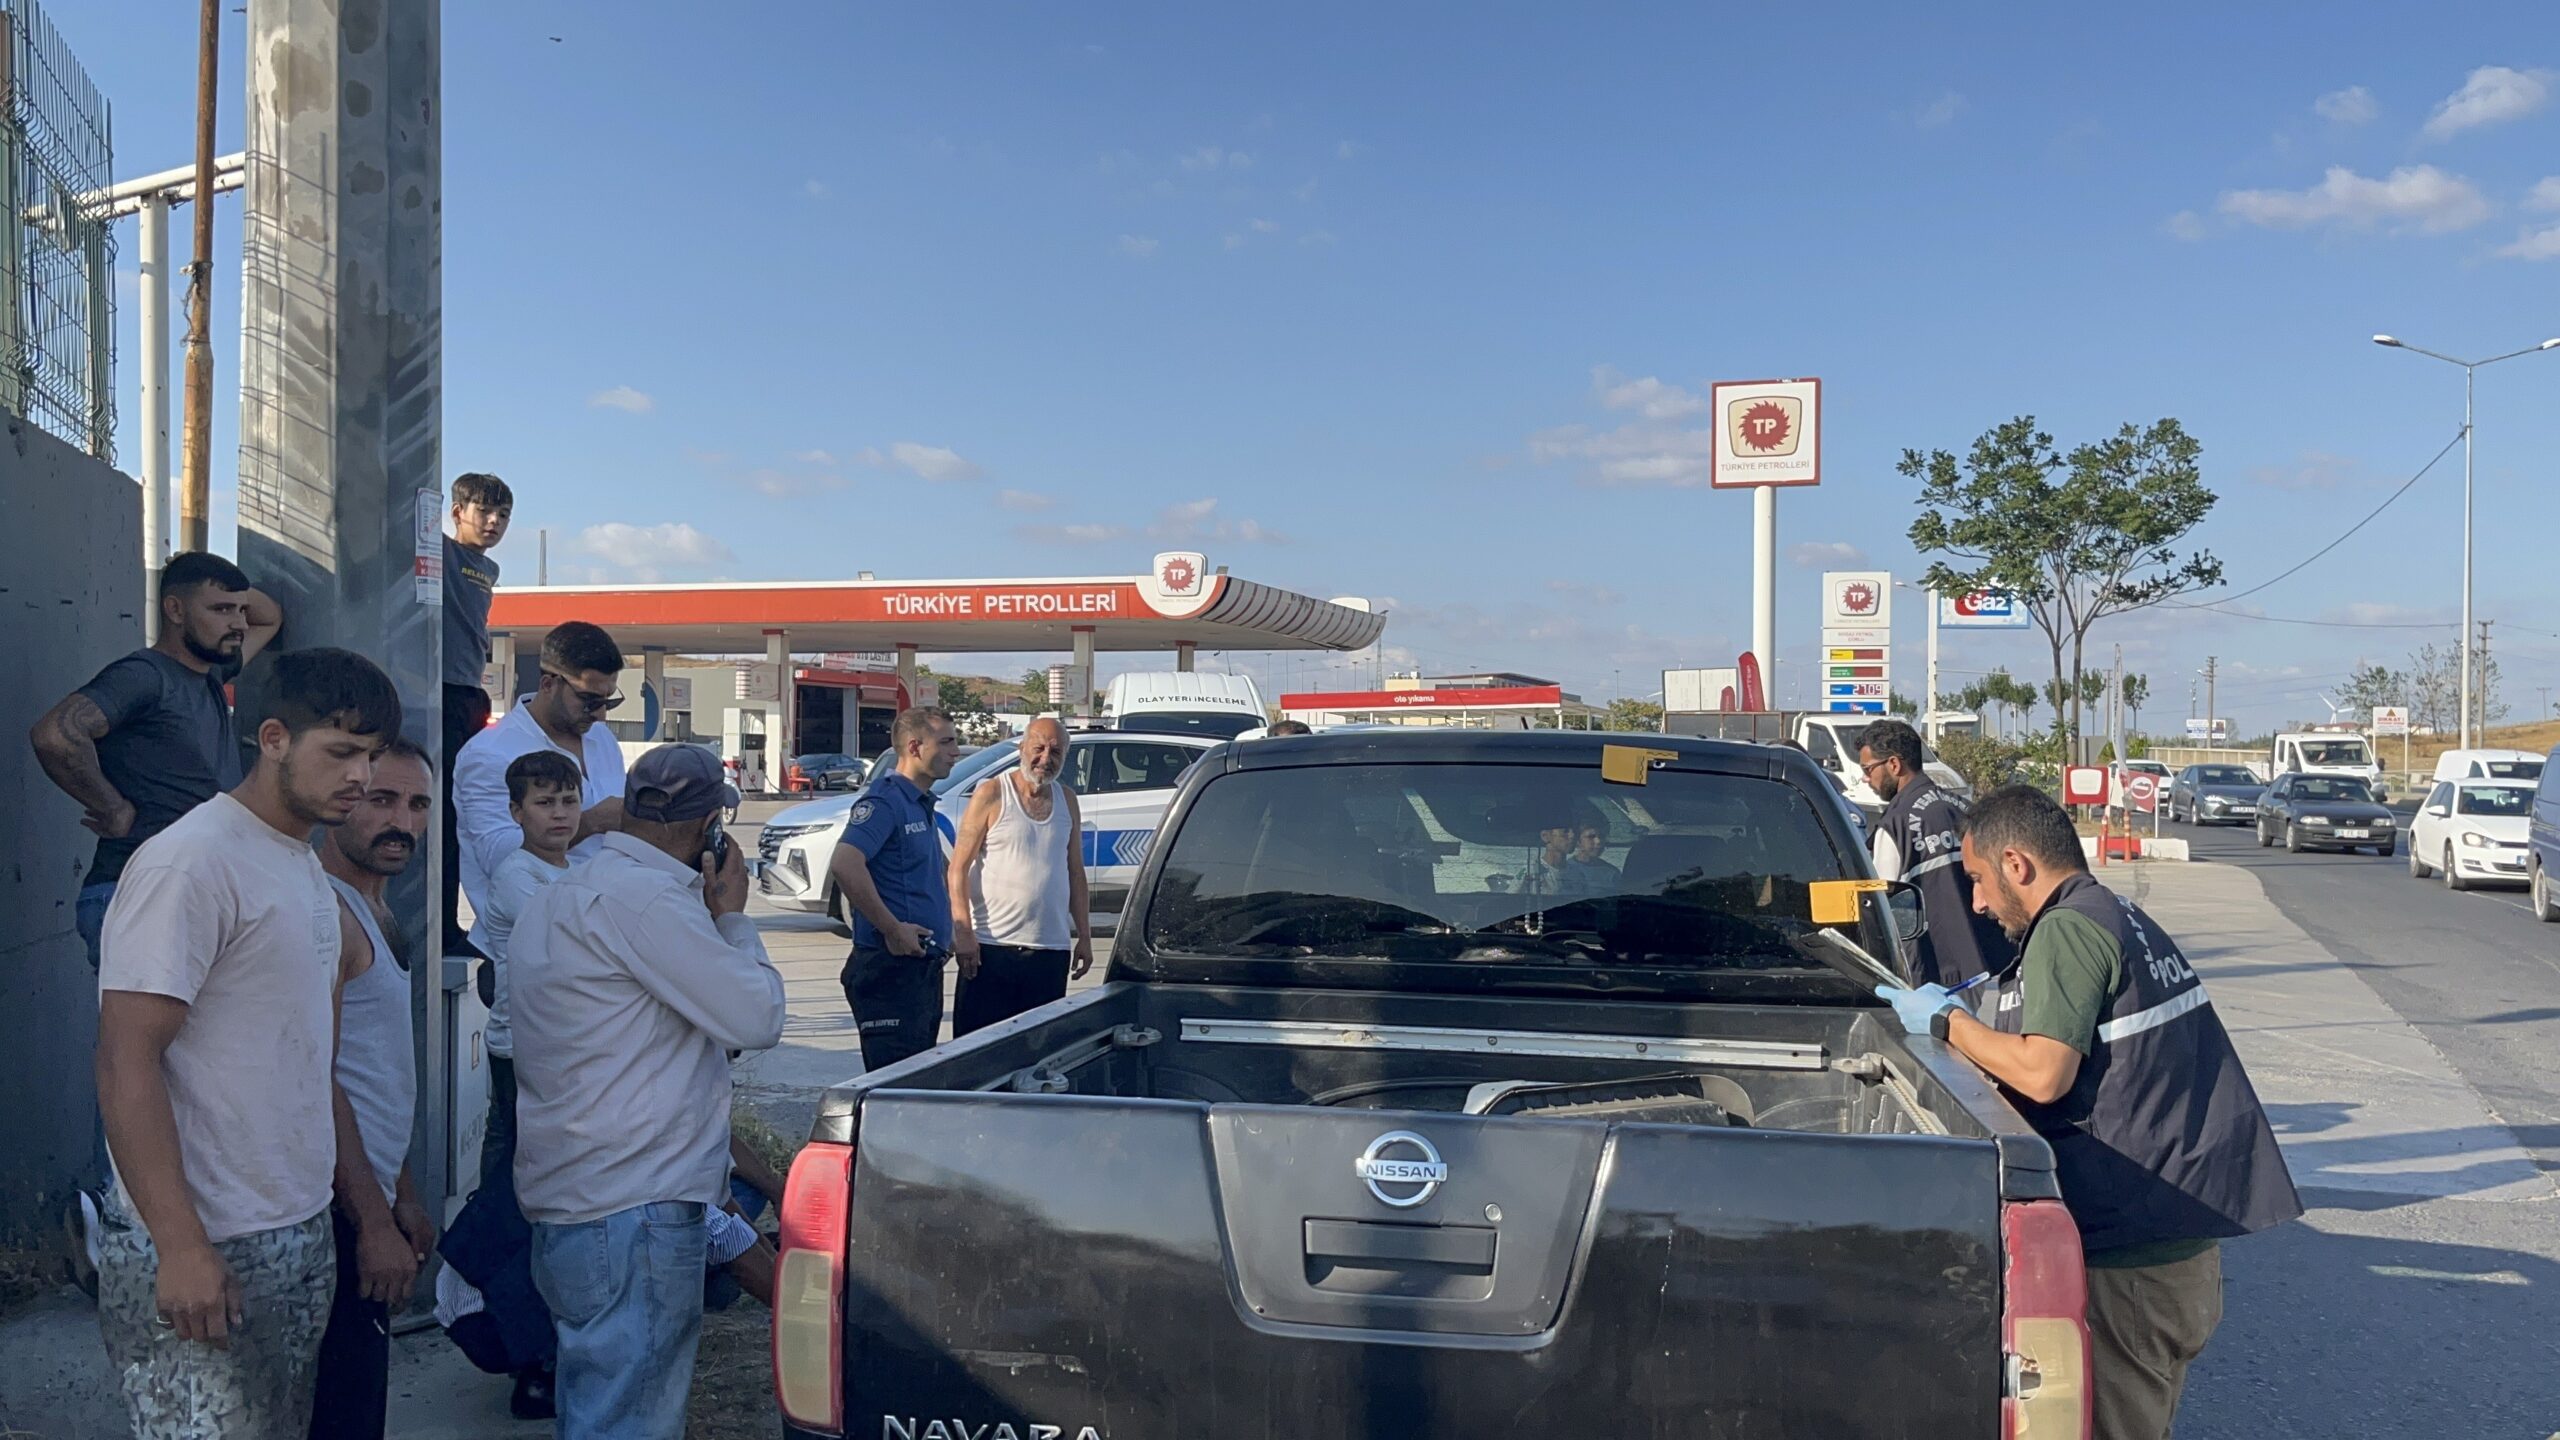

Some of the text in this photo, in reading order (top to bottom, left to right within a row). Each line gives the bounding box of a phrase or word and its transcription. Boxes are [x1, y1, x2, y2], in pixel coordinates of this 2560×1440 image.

[1753, 418, 1777, 435] TP
[1721, 460, 1810, 472] TÜRKİYE PETROLLERİ
[1170, 568, 1187, 581] TP
[883, 589, 1117, 615] TÜRKİYE PETROLLERİ
[1850, 592, 1866, 603] TP
[1964, 592, 2009, 611] Gaz
[1138, 695, 1247, 706] OLAY YERİ İNCELEME
[1908, 812, 1926, 852] OLAY
[1366, 1163, 1437, 1178] NISSAN
